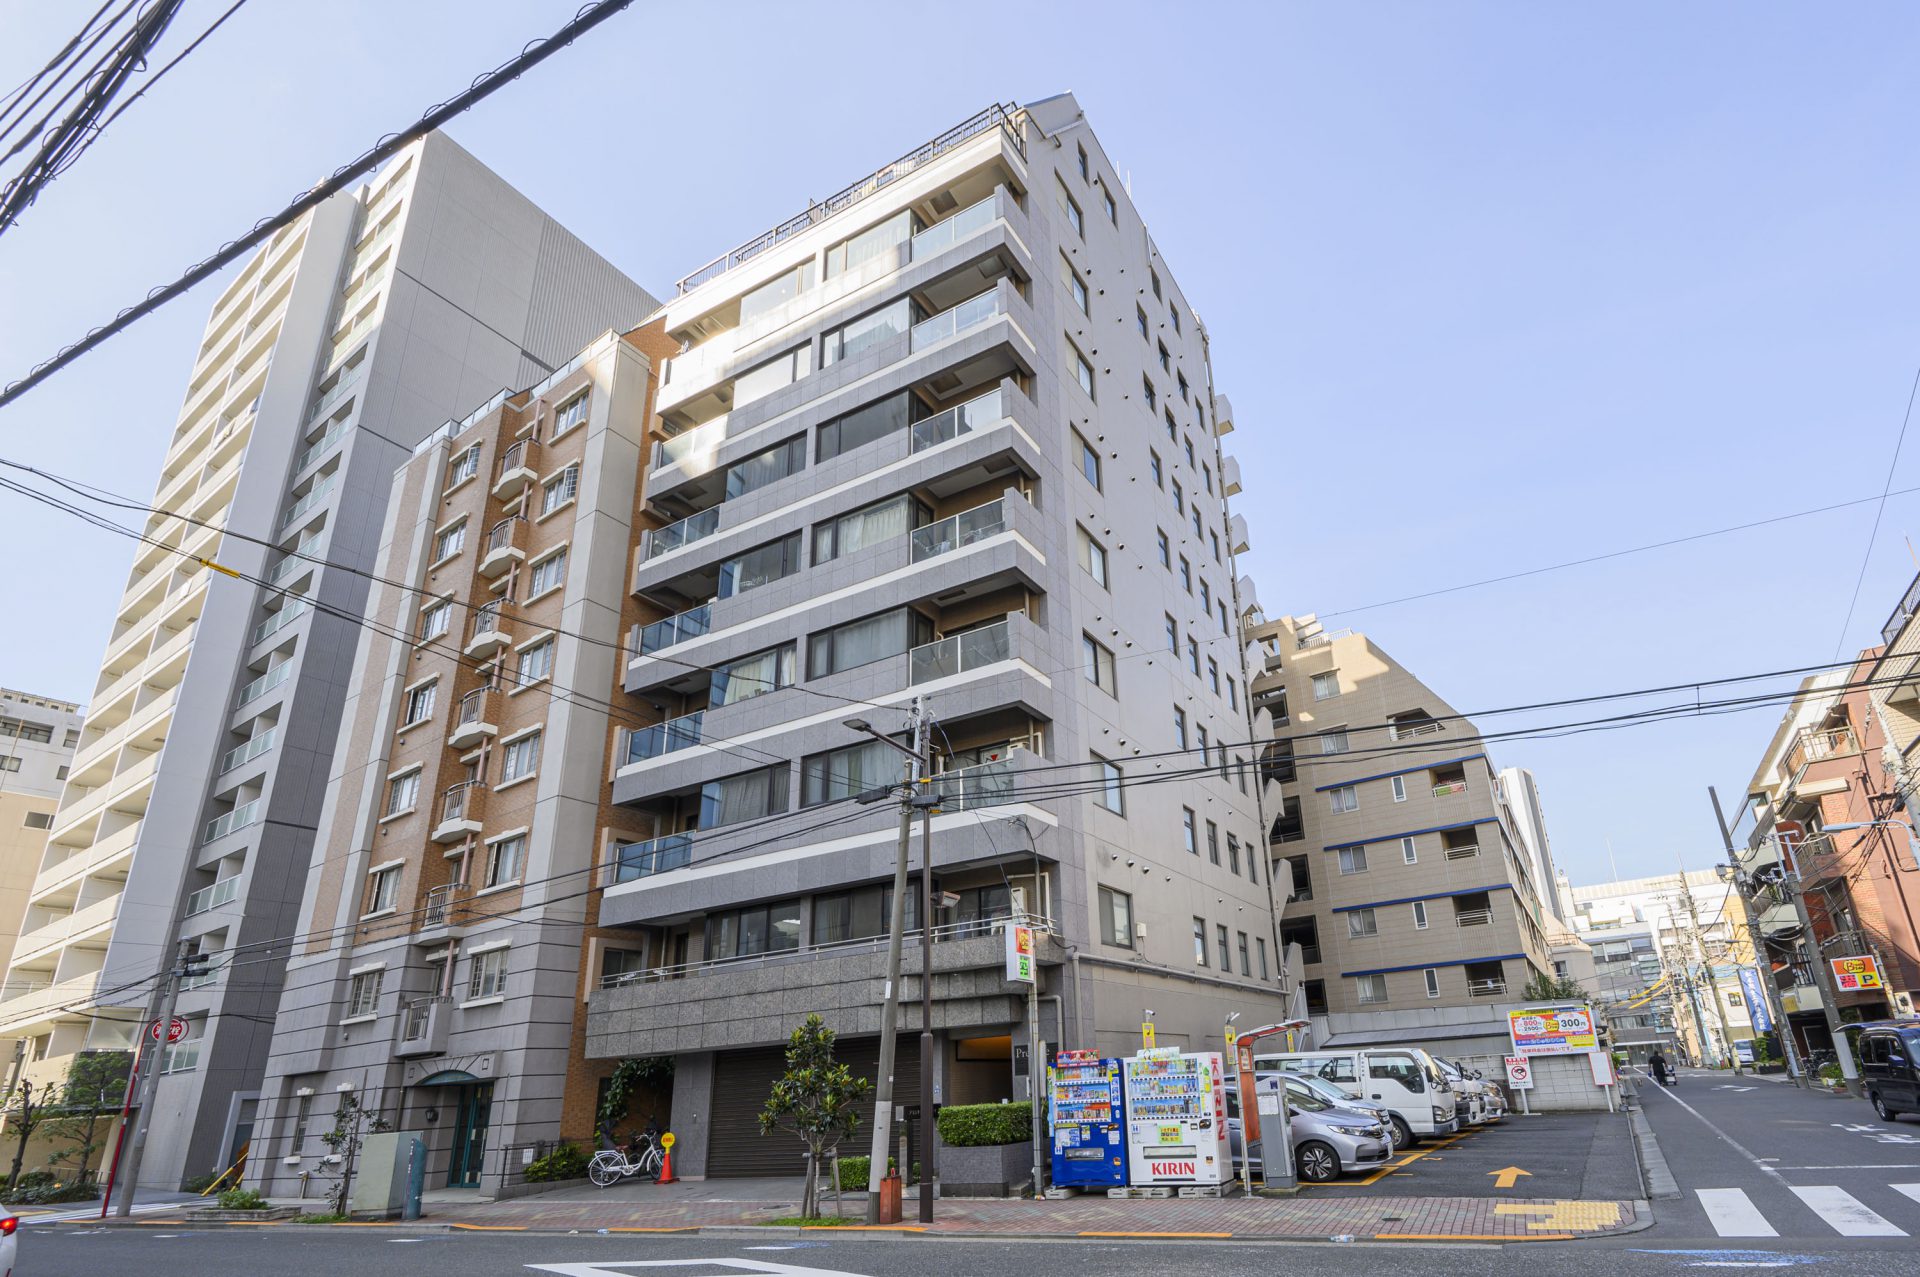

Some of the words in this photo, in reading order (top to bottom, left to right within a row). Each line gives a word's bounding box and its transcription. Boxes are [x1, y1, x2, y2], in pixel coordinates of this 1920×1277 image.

[1862, 974, 1874, 984] P
[1210, 1058, 1225, 1141] KIRIN
[1151, 1162, 1195, 1176] KIRIN
